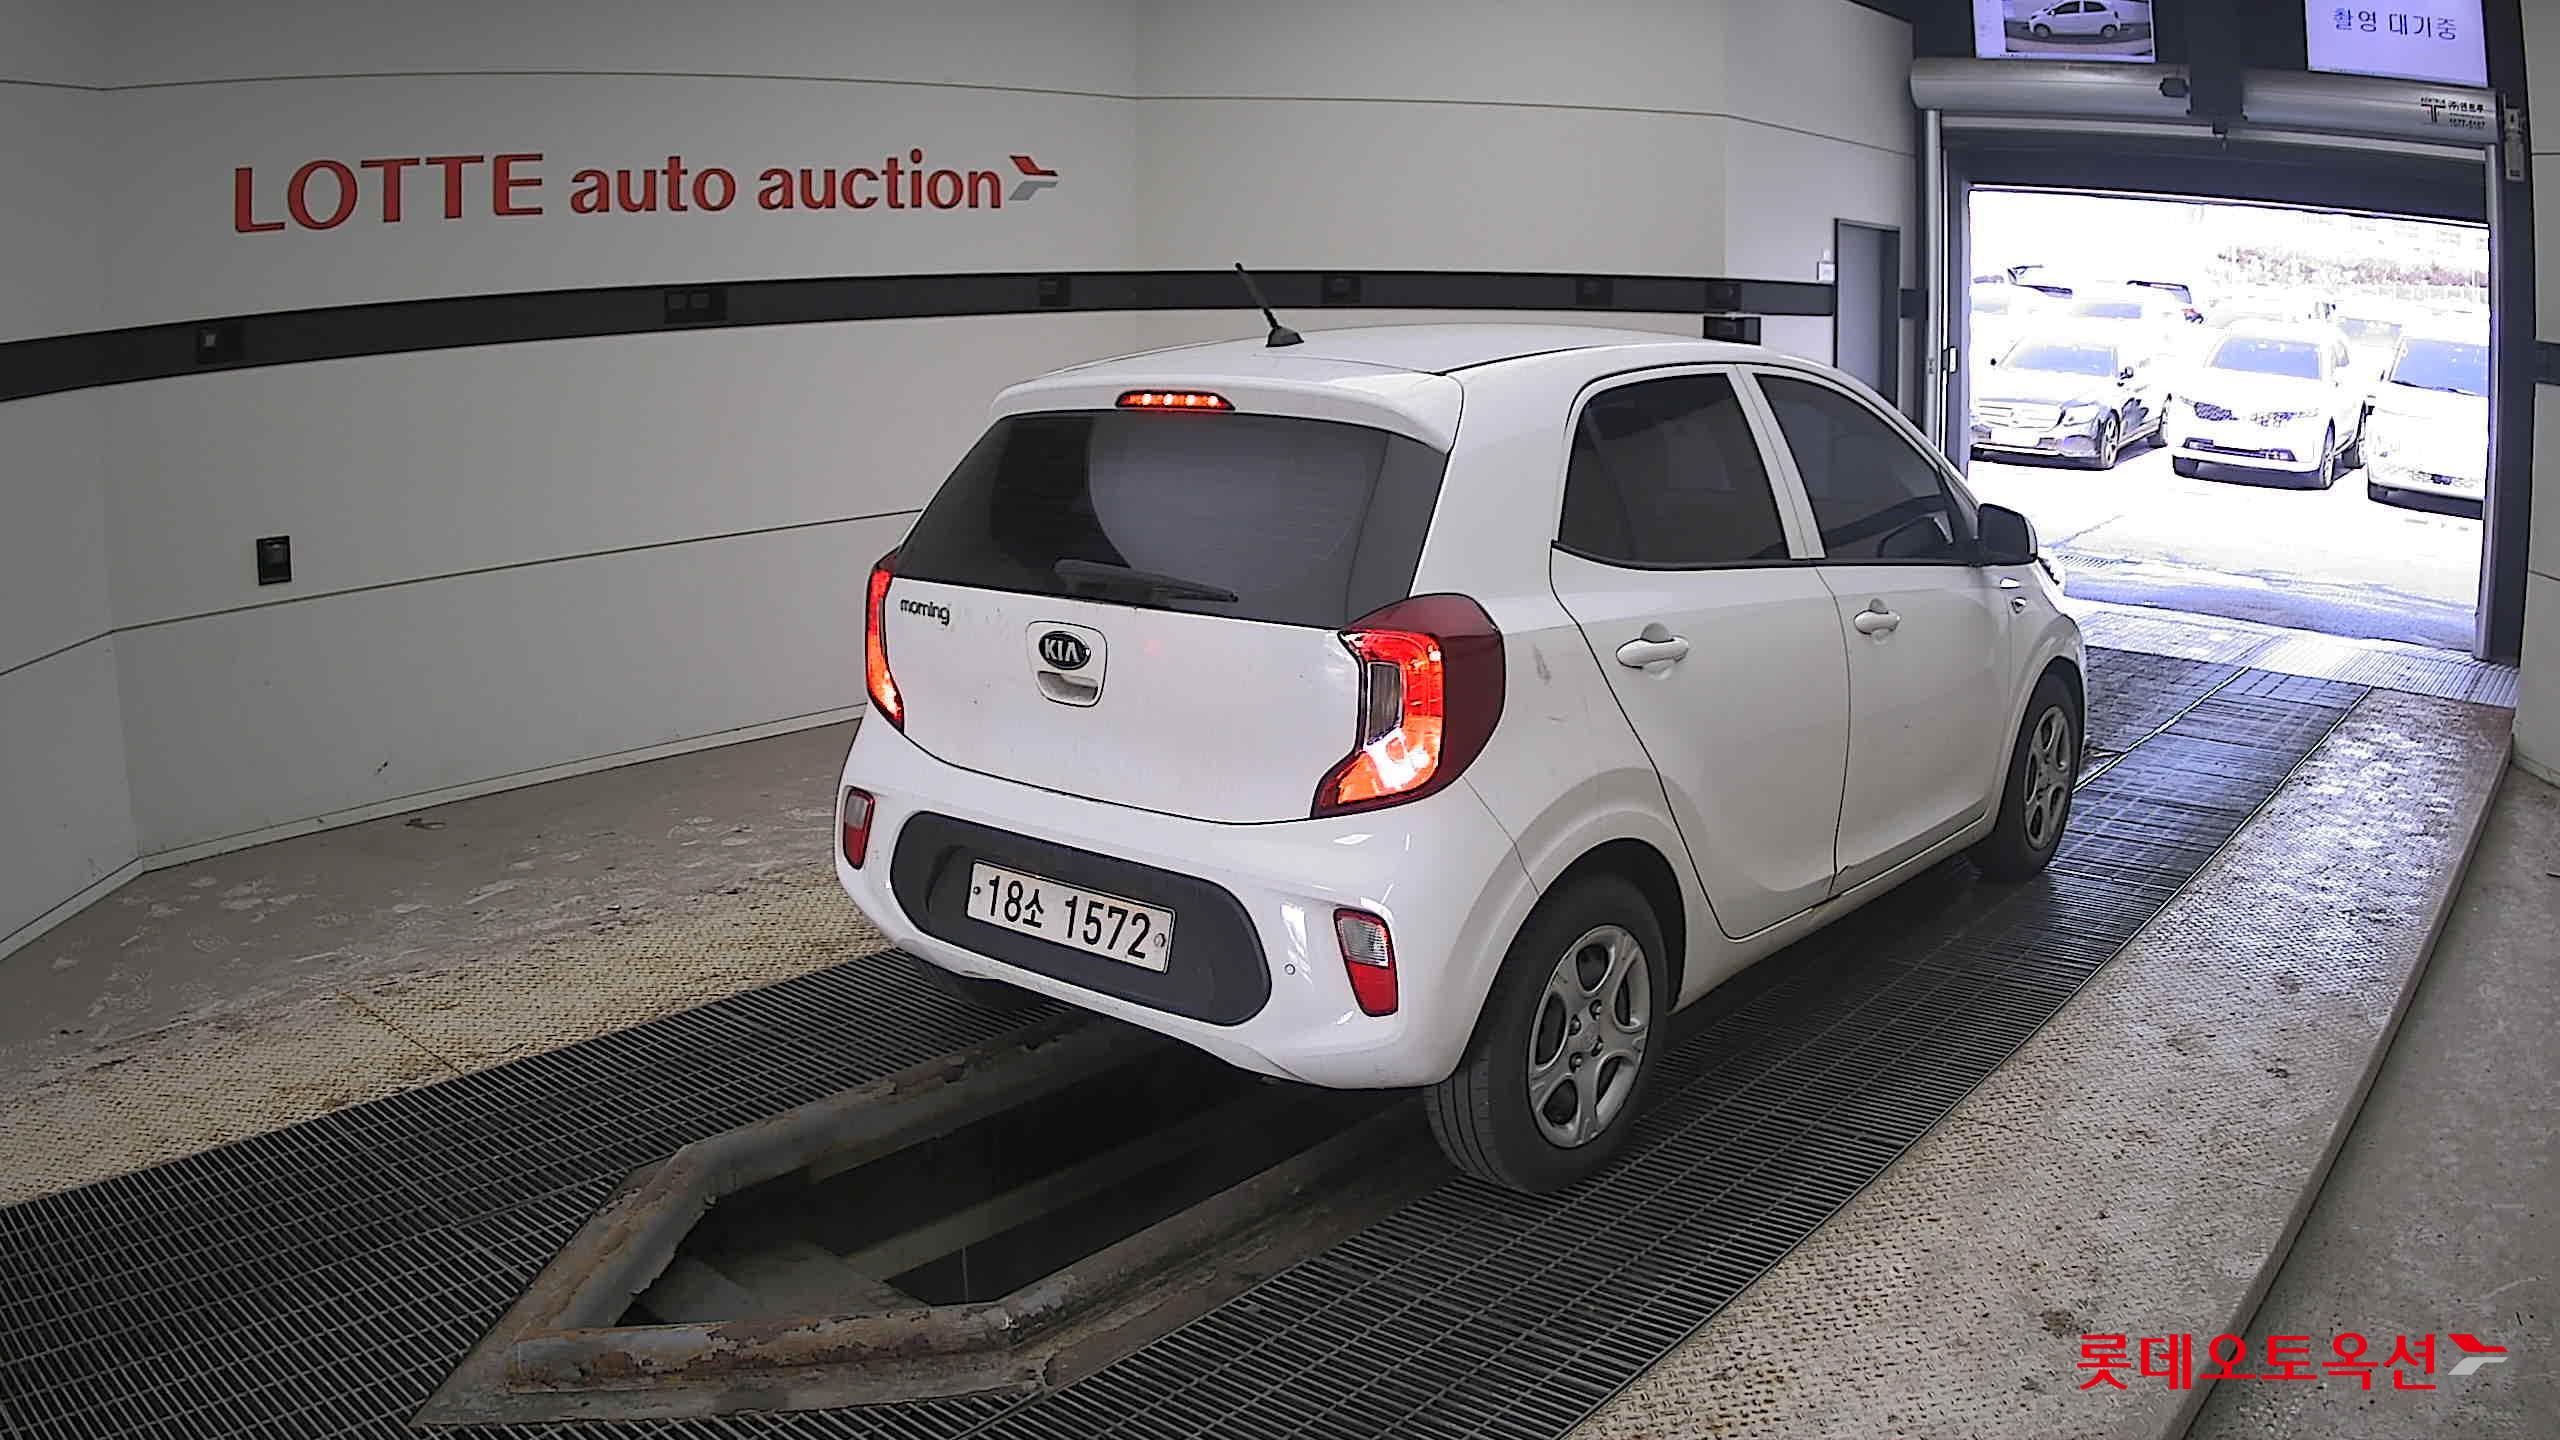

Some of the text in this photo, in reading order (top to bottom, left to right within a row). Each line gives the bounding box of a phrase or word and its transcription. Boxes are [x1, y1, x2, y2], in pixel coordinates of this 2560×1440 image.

[2388, 13, 2457, 41] 대기중
[235, 148, 1003, 233] LOTTE auto auction
[900, 599, 951, 626] morning
[1044, 637, 1081, 663] KIA
[988, 875, 1151, 959] 18소 1572
